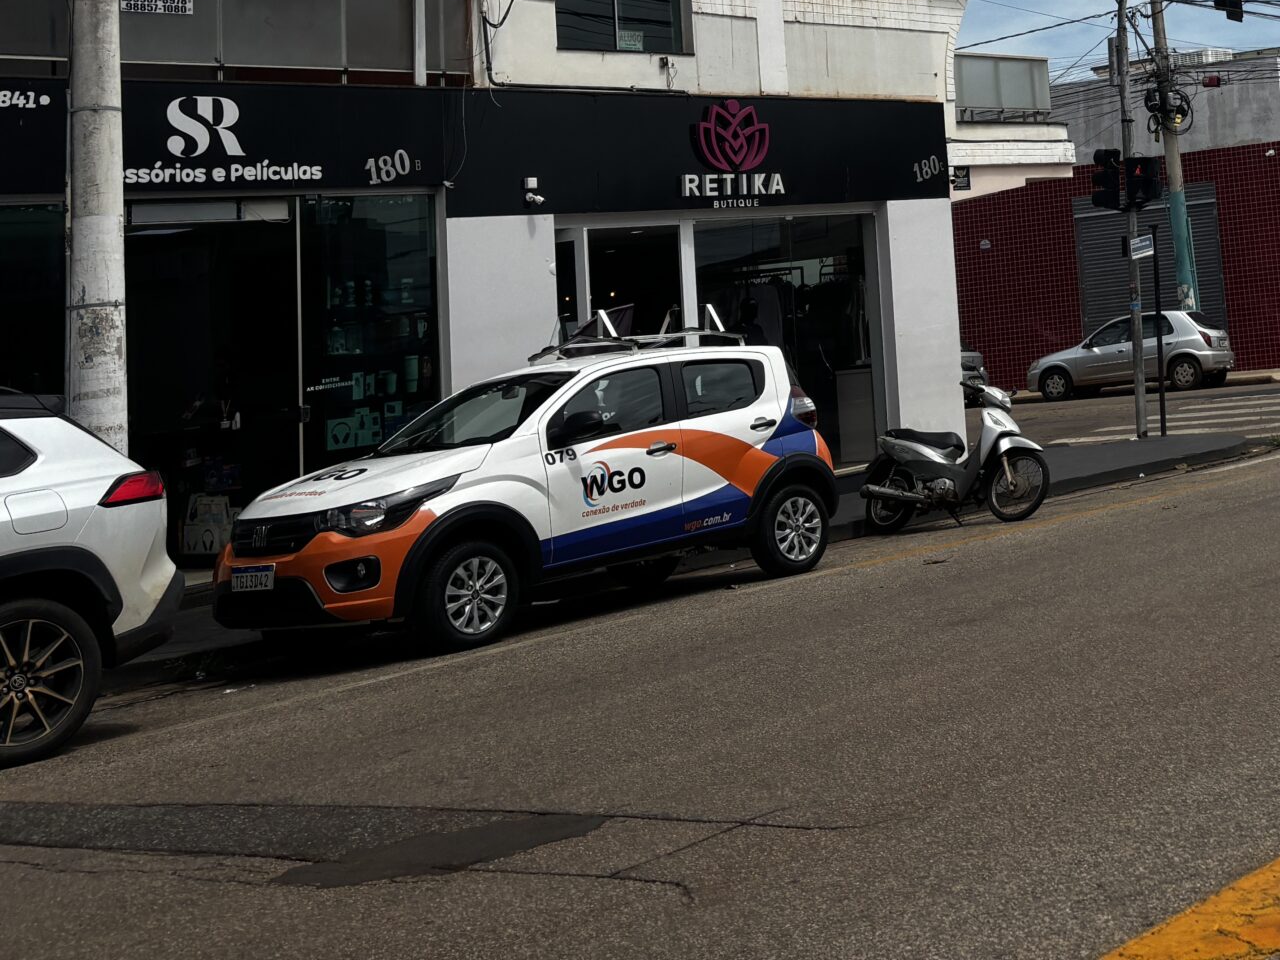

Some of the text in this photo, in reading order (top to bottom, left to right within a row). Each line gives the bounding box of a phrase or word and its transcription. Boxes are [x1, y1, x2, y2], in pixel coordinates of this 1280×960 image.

[126, 3, 187, 13] 98857-1080
[166, 95, 247, 158] SR
[122, 159, 323, 183] ssórios e Películas
[364, 148, 422, 185] 180 B
[913, 154, 940, 183] 180
[681, 173, 785, 197] RETIKA
[713, 198, 760, 208] BUTIQUE
[544, 448, 577, 465] 079
[581, 467, 646, 498] WGO
[582, 498, 647, 518] conexão de verdade
[684, 511, 732, 532] wgo.com.br
